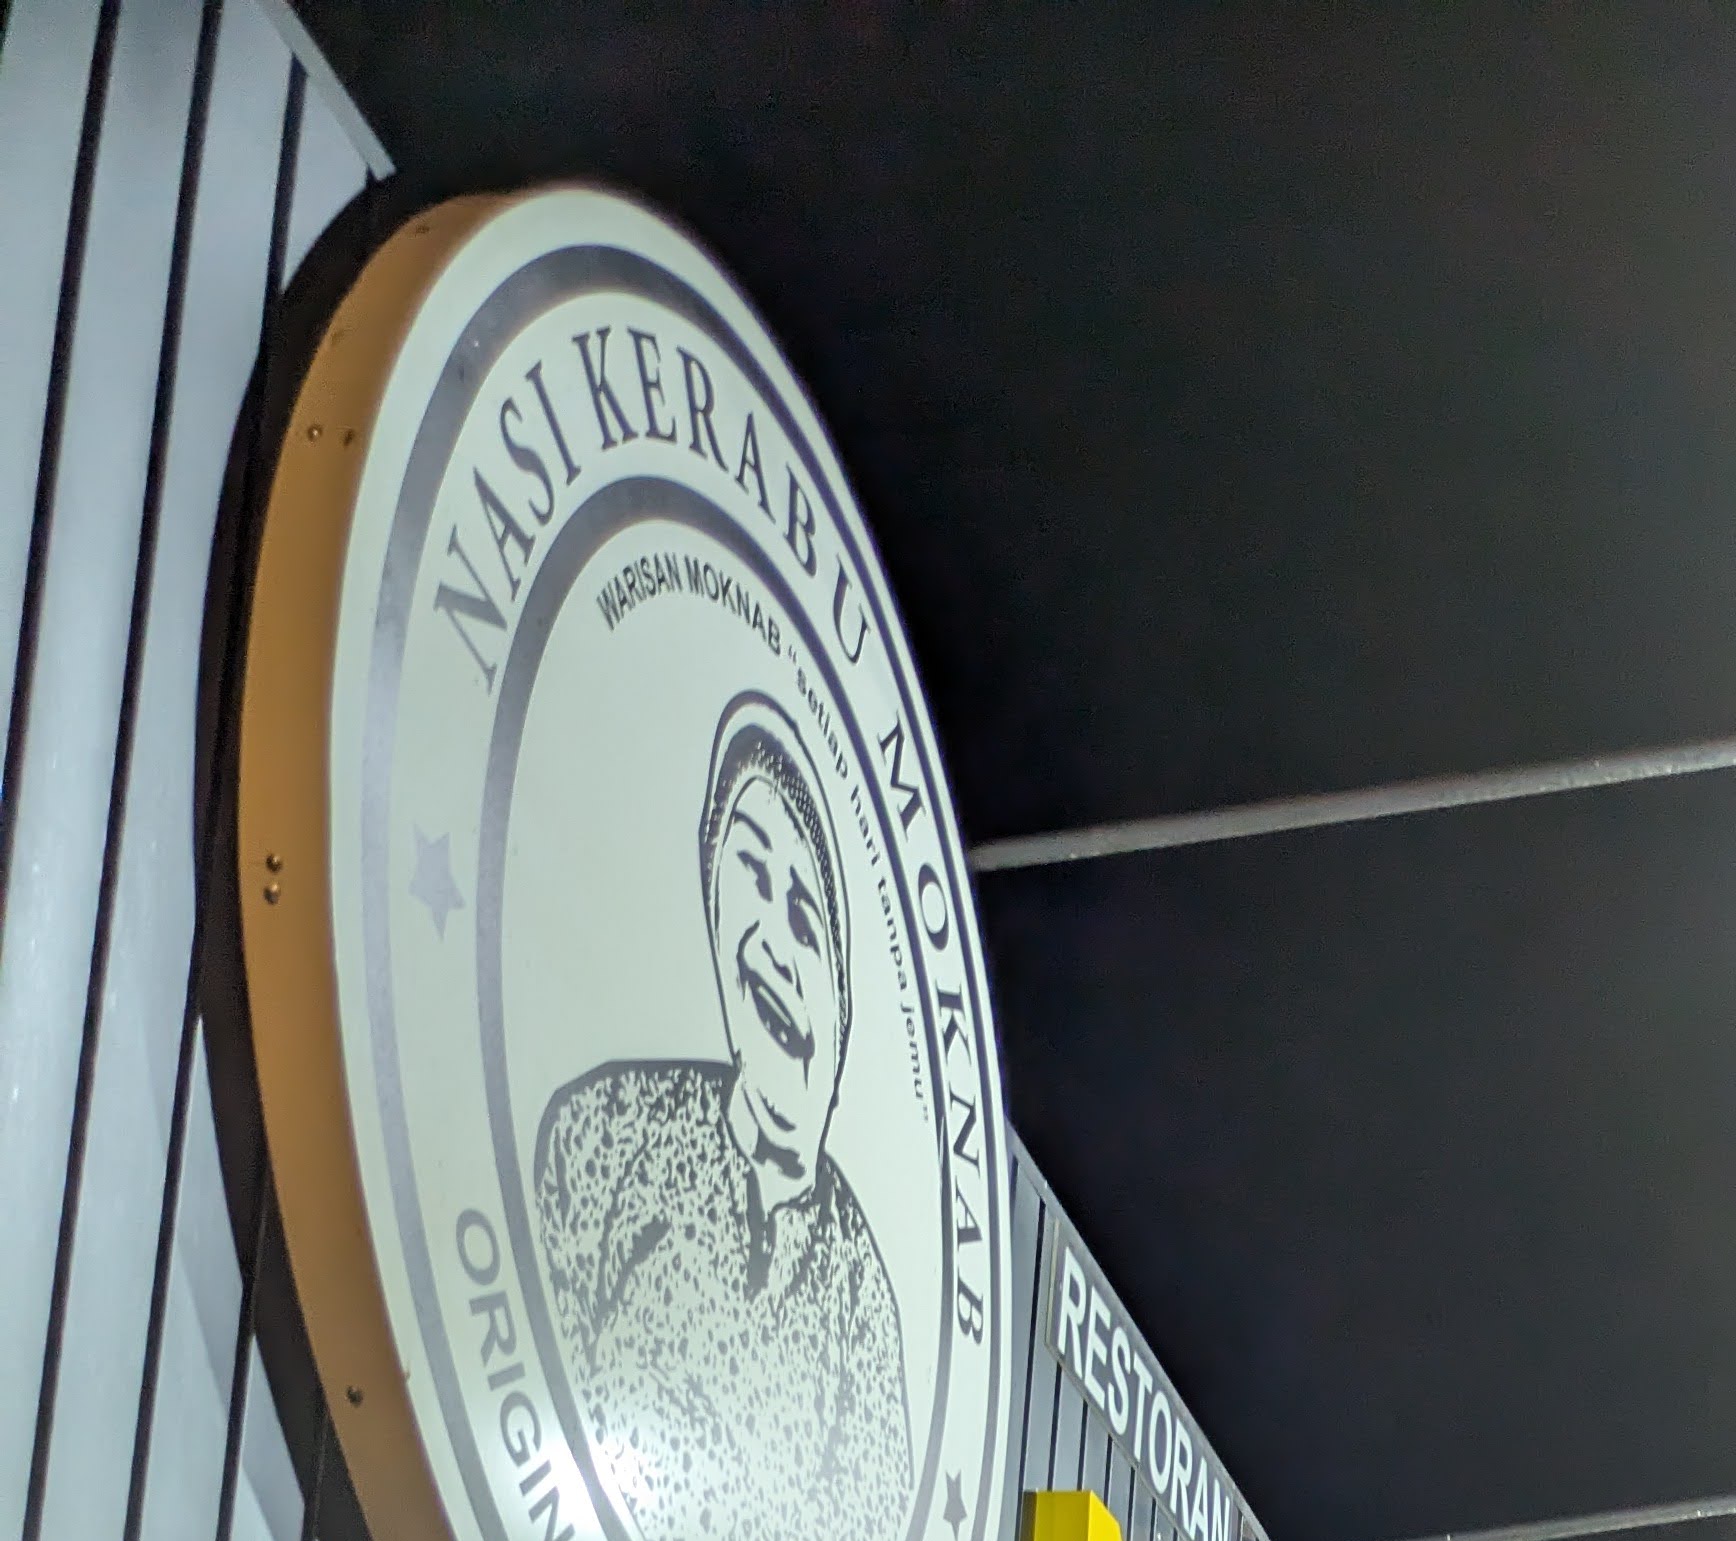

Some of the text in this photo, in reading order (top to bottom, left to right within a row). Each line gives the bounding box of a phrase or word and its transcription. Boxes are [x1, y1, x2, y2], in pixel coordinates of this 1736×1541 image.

[433, 325, 985, 1346] NASI KERABU MOKNAB
[596, 551, 682, 632] WARISAN
[684, 553, 782, 657] MOKNAB
[850, 783, 882, 867] hari
[876, 874, 909, 993] tanpa
